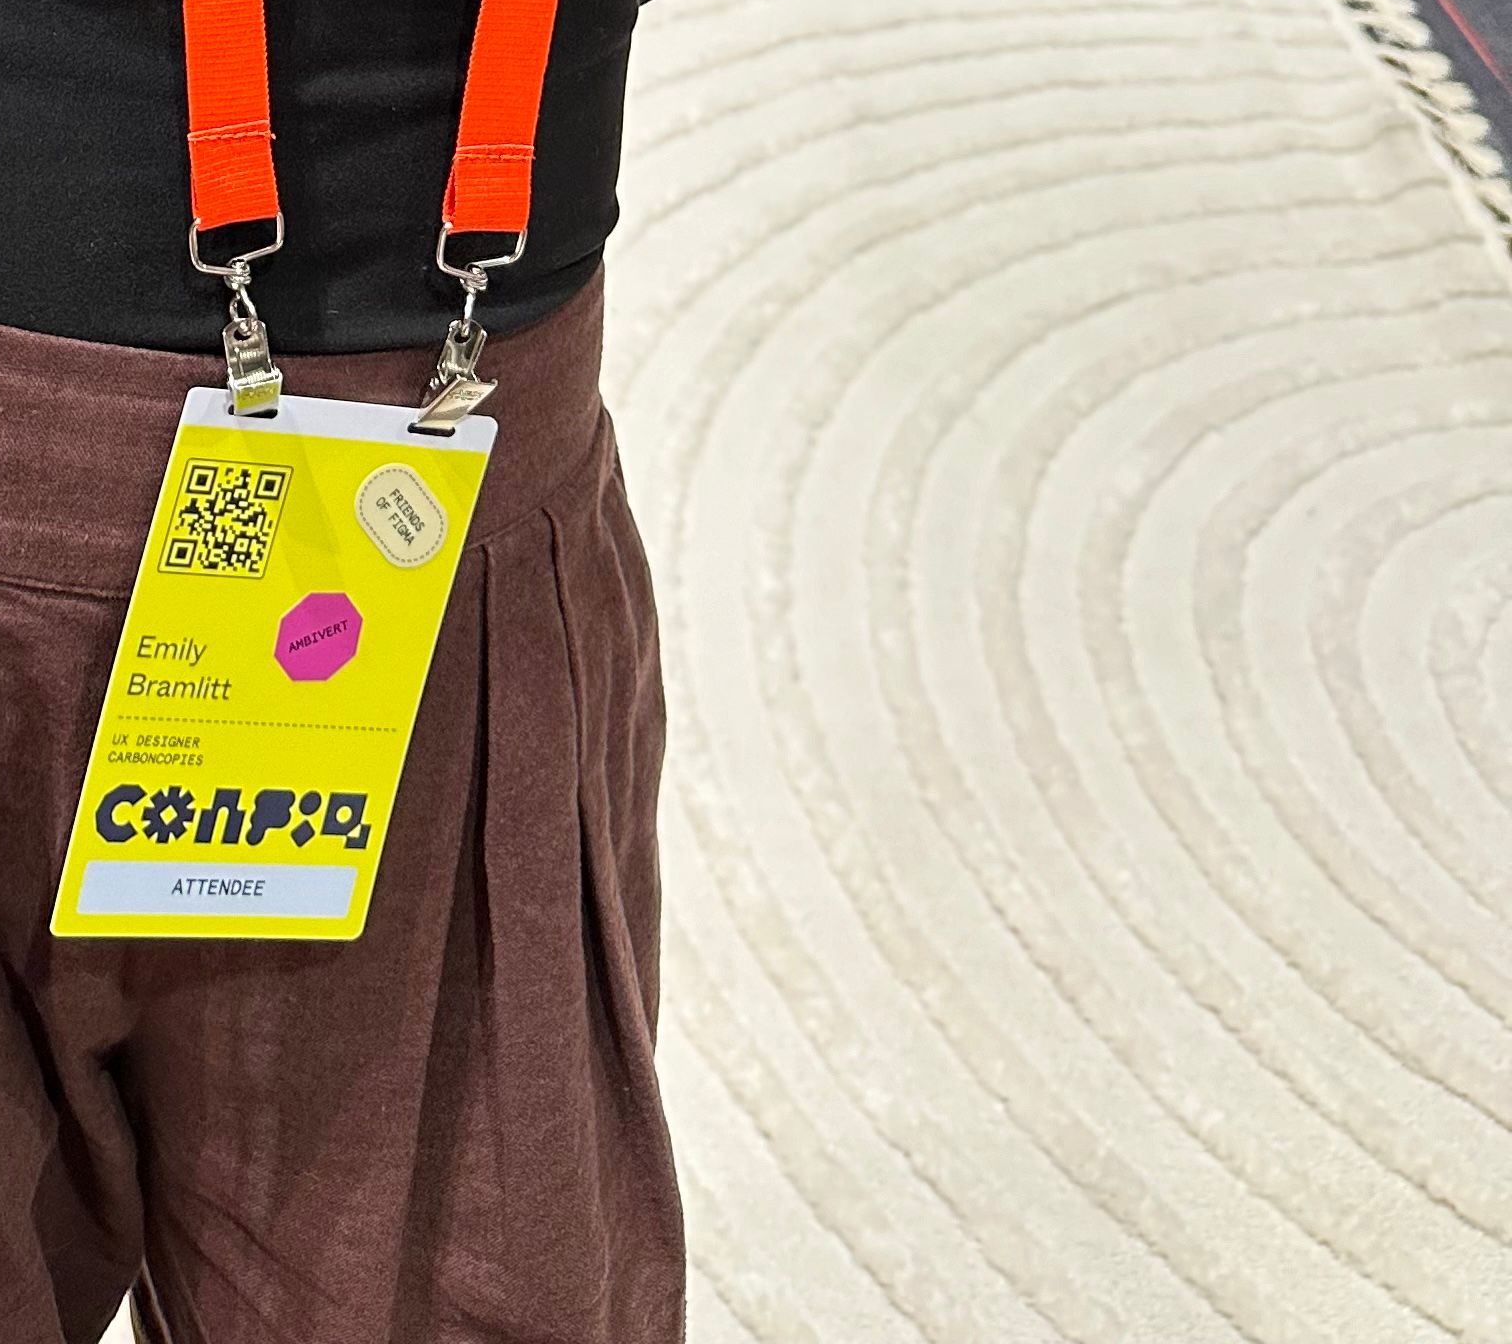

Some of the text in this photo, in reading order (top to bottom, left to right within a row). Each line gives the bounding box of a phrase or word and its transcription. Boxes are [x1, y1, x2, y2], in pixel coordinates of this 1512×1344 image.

[376, 496, 415, 546] OF FIGMA
[389, 488, 426, 532] FRIENDS
[137, 635, 207, 667] Emily
[288, 619, 349, 654] AMBIVERT
[126, 673, 232, 701] Bramlitt
[111, 733, 201, 749] UX DESIGNER
[107, 750, 204, 766] CARBONCOPIES
[171, 878, 266, 897] ATTENDEE
